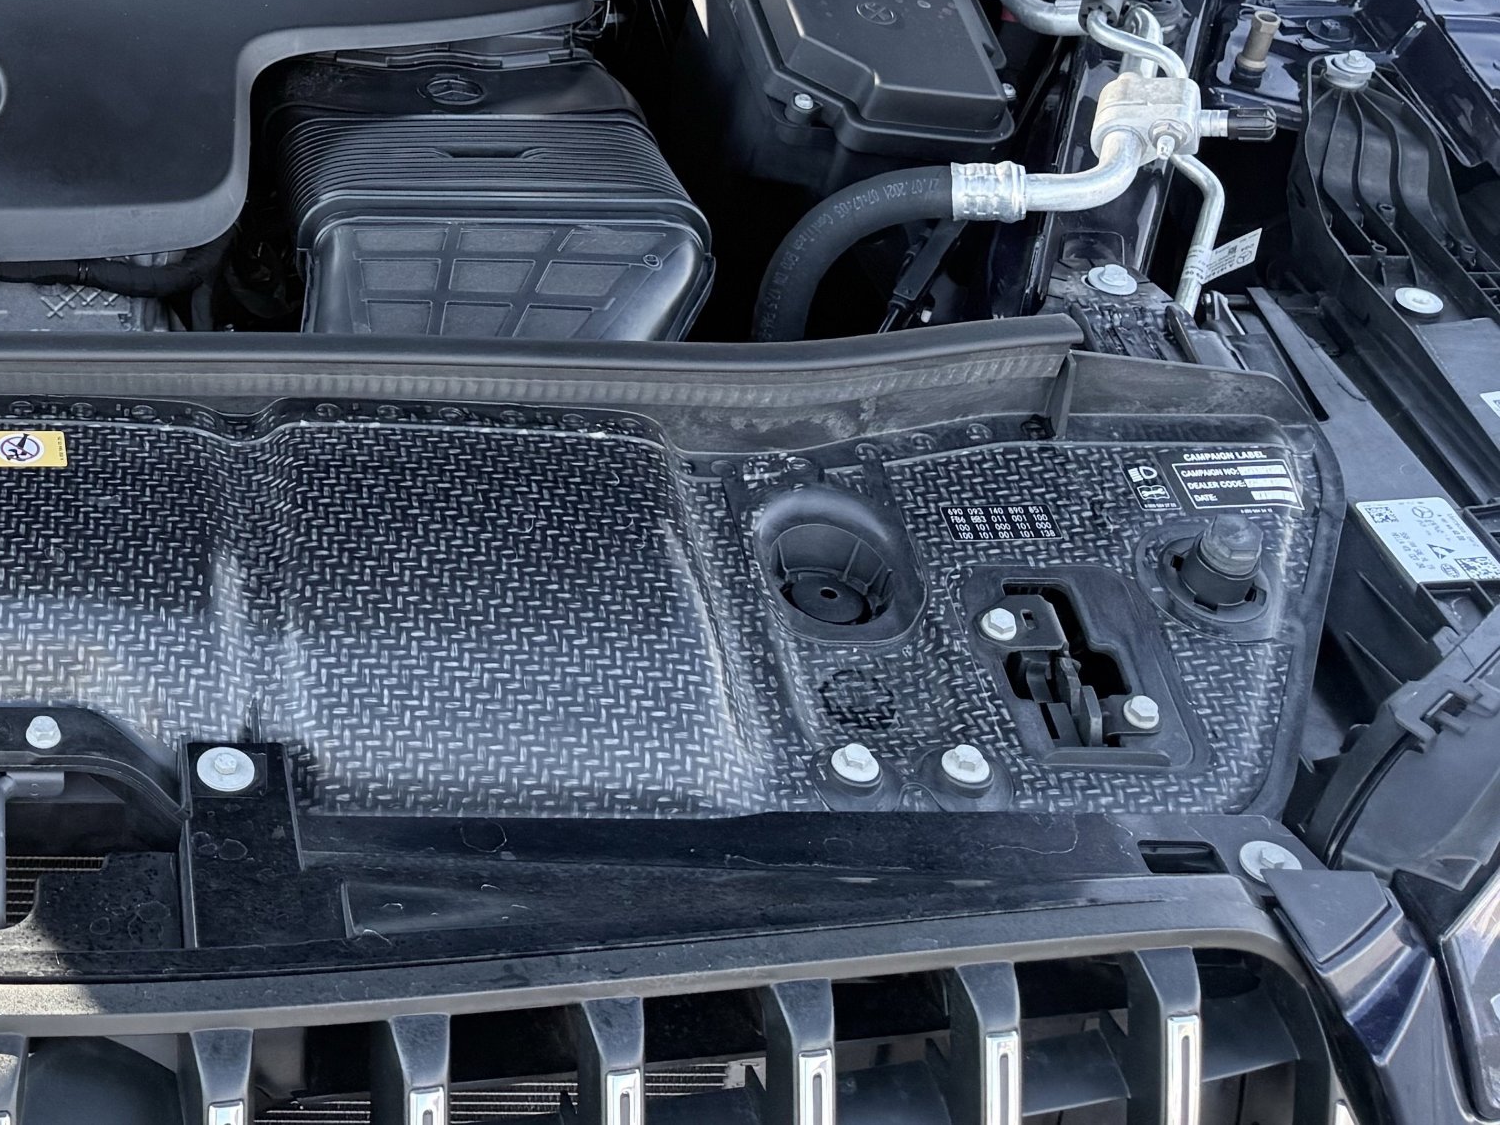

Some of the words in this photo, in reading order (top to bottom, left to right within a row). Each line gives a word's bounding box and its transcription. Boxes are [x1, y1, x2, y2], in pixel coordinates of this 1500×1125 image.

[1183, 453, 1235, 461] CAMPAIGN
[1237, 451, 1267, 459] LABEL
[1181, 469, 1222, 477] CAMPAIGN
[1224, 468, 1239, 476] NO:
[1187, 482, 1220, 490] DEALER
[1220, 480, 1246, 488] CODE:
[1194, 494, 1218, 502] DATE:
[1016, 522, 1031, 530] 101
[959, 532, 973, 540] 100
[1020, 530, 1034, 538] 101
